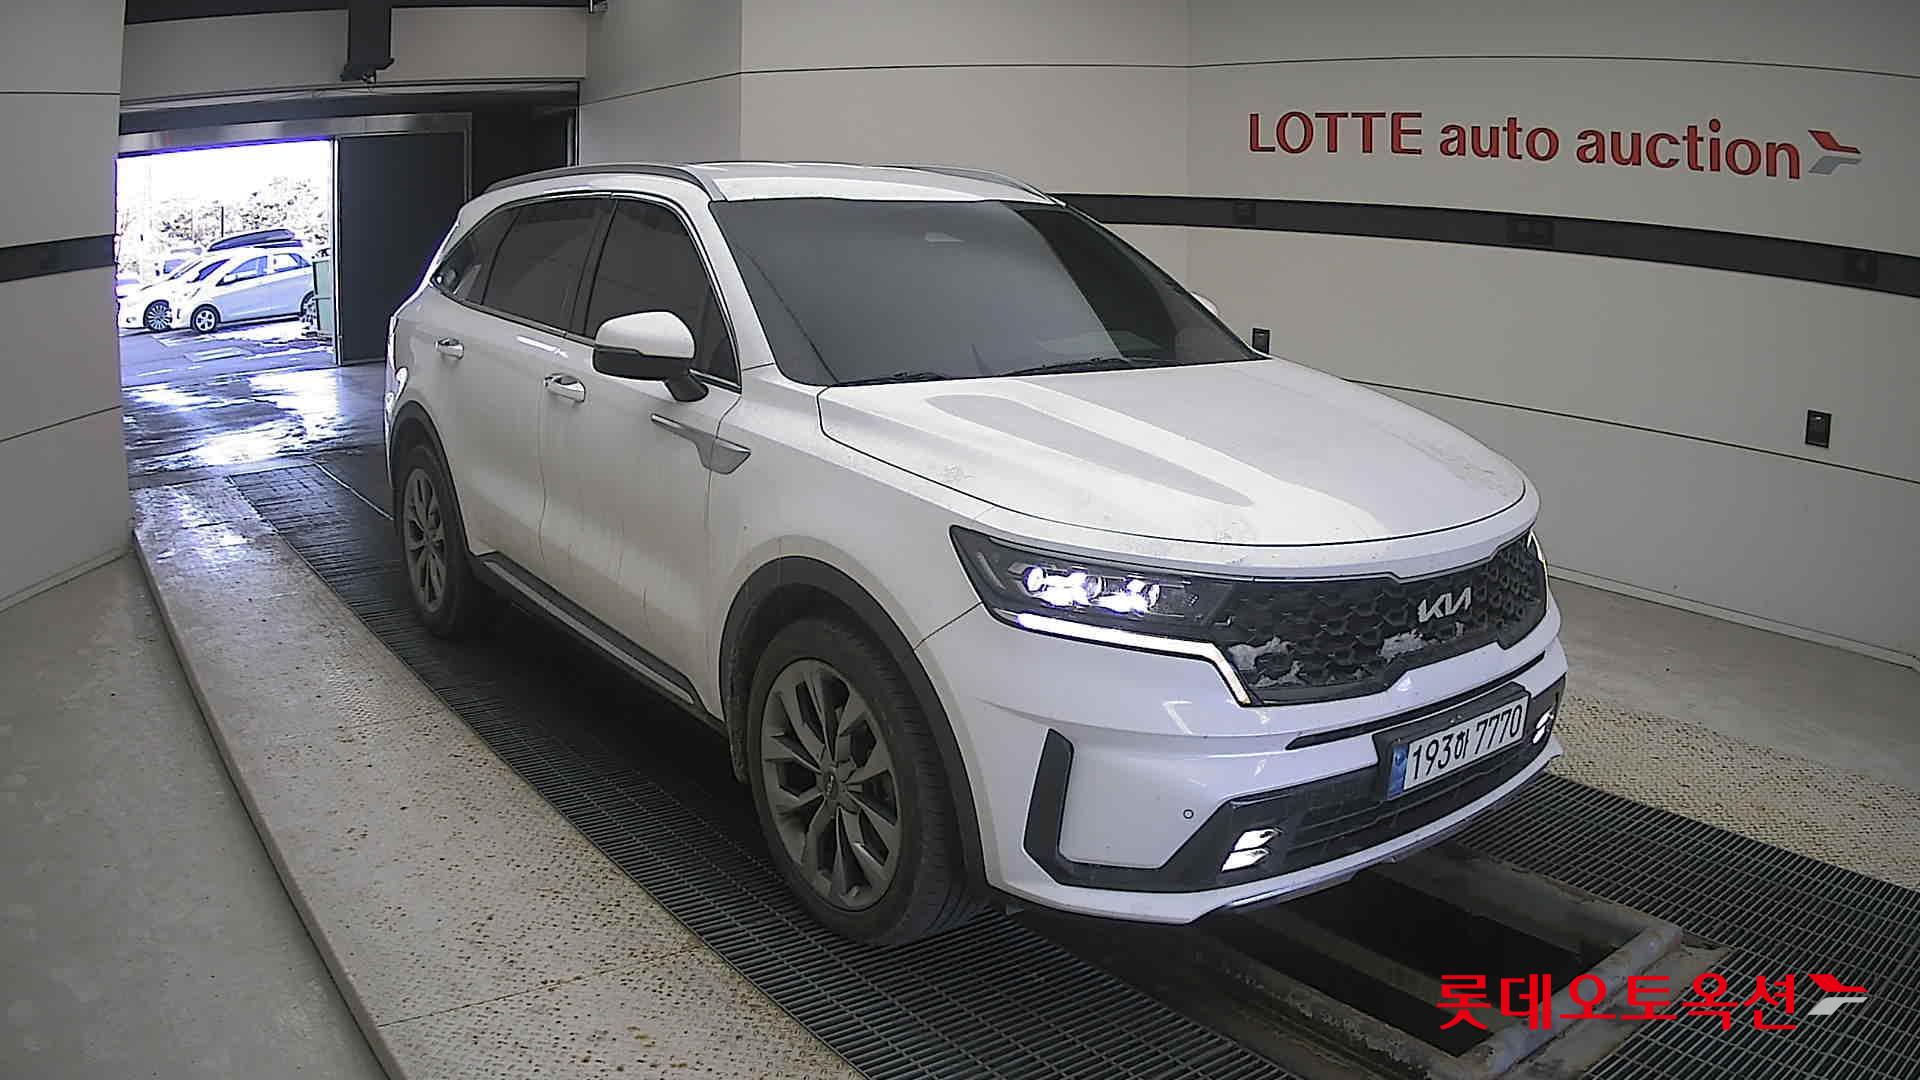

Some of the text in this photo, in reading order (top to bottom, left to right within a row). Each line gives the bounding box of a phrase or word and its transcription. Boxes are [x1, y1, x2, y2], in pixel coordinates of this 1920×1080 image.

[1248, 111, 1801, 180] LOTTE auto auction
[1417, 586, 1472, 623] KIA
[1475, 704, 1523, 755] 7770
